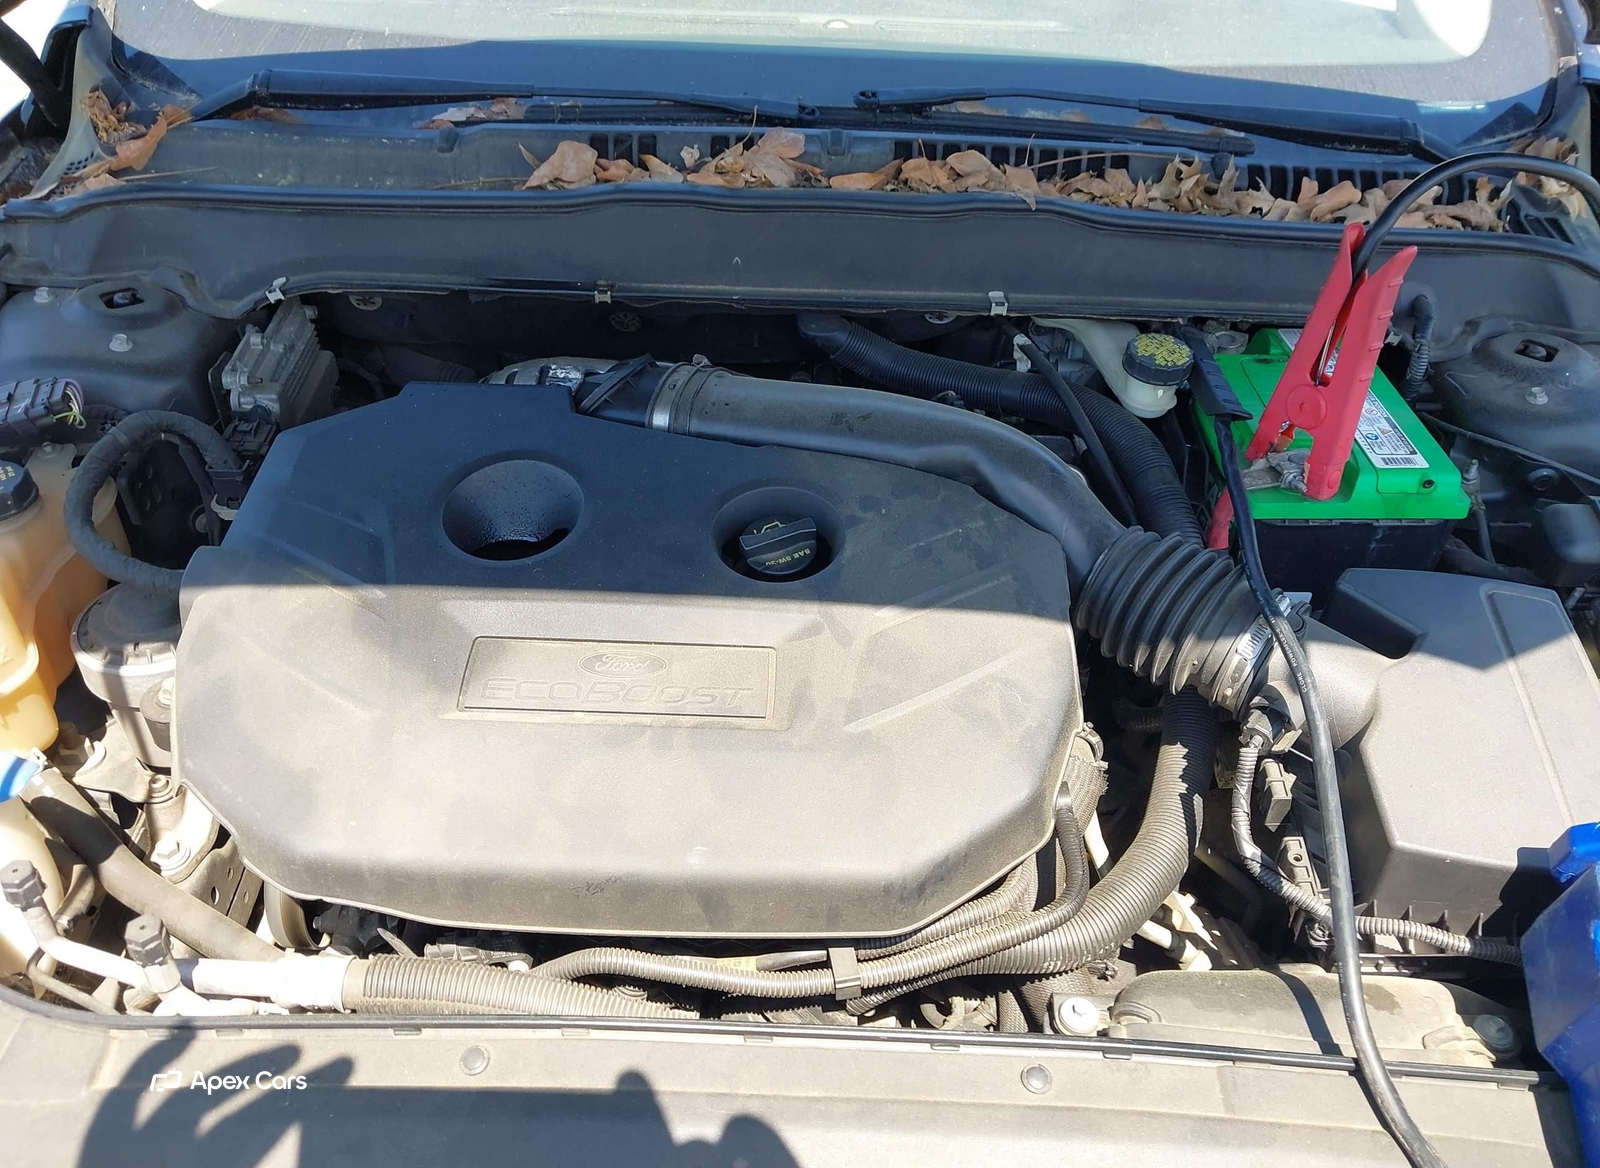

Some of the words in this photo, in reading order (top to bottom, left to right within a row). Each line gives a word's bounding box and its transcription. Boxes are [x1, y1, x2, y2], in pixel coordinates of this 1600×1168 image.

[792, 548, 811, 559] SAE
[594, 652, 650, 672] Ford
[1296, 671, 1308, 693] CLORE
[480, 678, 755, 708] ECOBOOST
